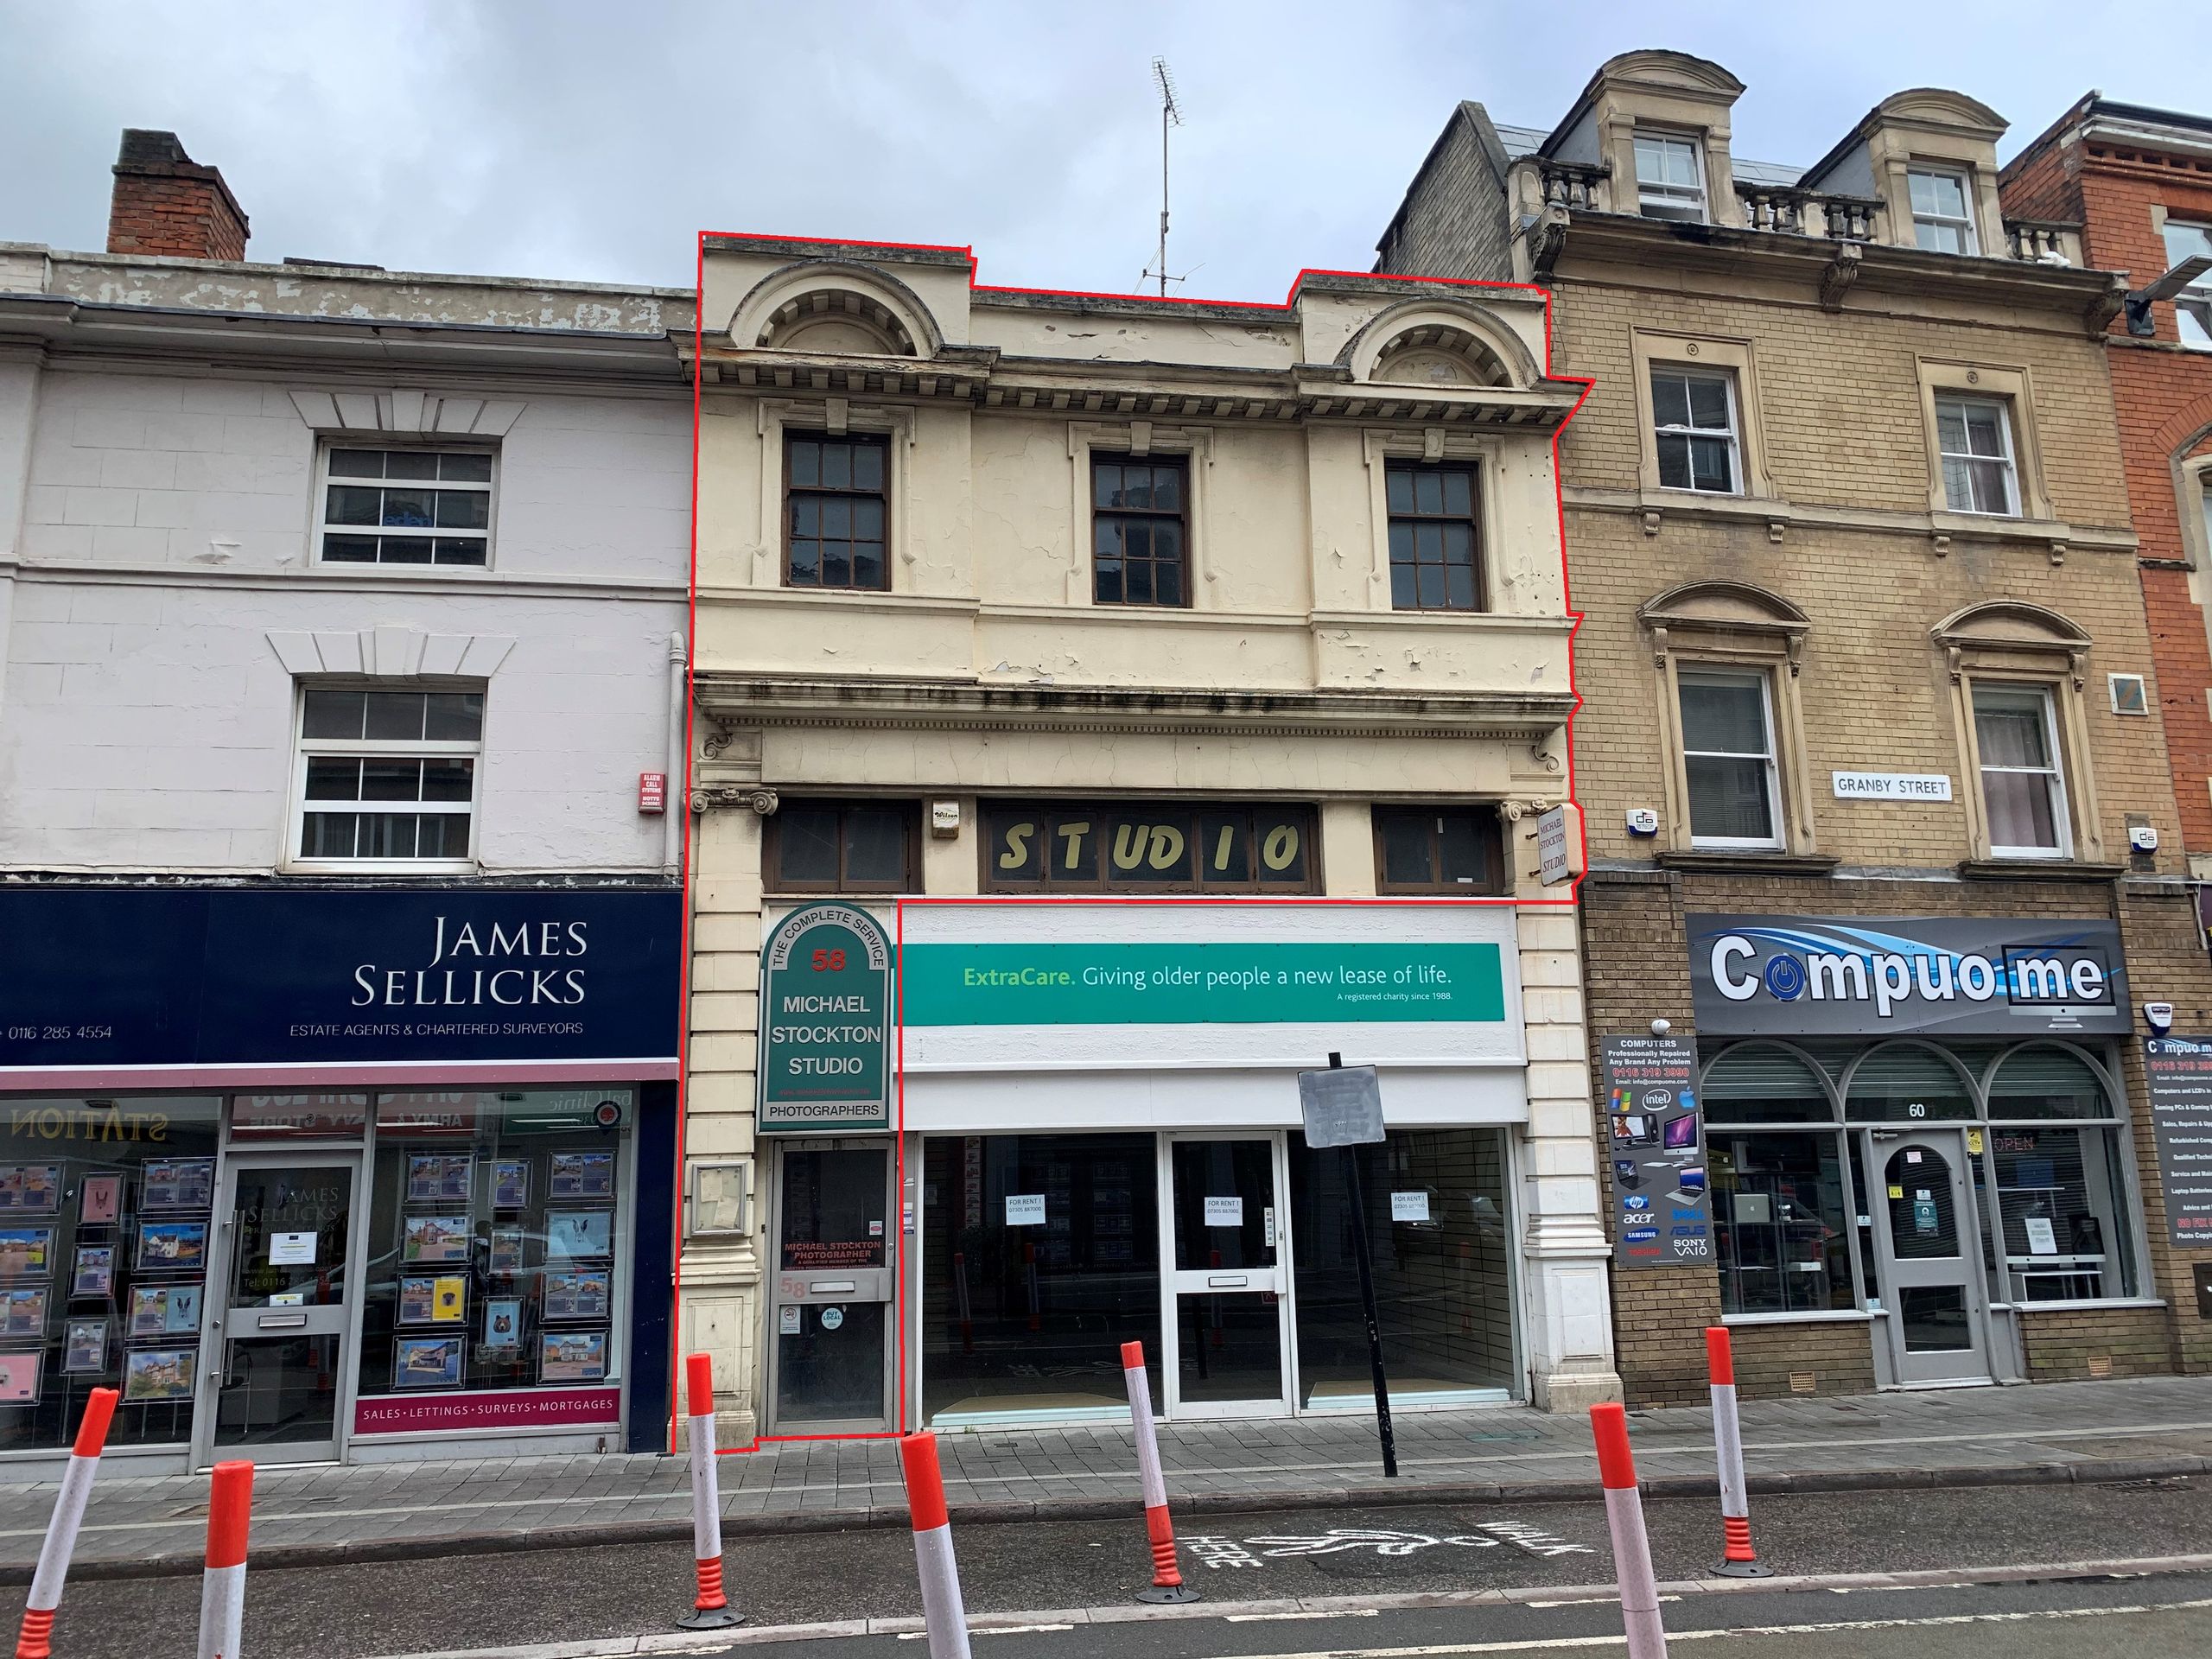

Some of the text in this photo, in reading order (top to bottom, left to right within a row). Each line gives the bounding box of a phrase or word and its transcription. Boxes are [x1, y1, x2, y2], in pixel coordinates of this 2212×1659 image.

[1838, 779, 1946, 794] GRANBY STREET
[1540, 817, 1562, 835] MICHAEL
[1000, 822, 1299, 870] STUDIO
[1540, 831, 1565, 849] STOCKTON
[1543, 854, 1566, 873] STUDIO
[428, 916, 588, 969] JAMES
[773, 910, 884, 966] THE COMPLETE SERVICE
[812, 949, 846, 971] 58
[351, 964, 586, 1006] SELLICKS
[964, 964, 1452, 991] ExtraCare. Giving older people a new lease of life.
[783, 995, 871, 1014] MICHAEL
[1344, 993, 1382, 1002] registered
[1382, 993, 1408, 1002] charity
[9, 1026, 111, 1039] 0116 285 4554
[290, 1022, 584, 1037] ESTATE AGENTS & CHARTERED SURVEYORS
[772, 1026, 881, 1044] STOCKTON
[1620, 1039, 1677, 1048] COMPUTERS
[788, 1057, 863, 1075] STUDIO
[1612, 1067, 1640, 1077] 0116
[1641, 1067, 1662, 1077] 319
[1646, 1094, 1667, 1104] intel
[770, 1104, 879, 1117] PHOTOGRAPHERS
[1909, 1103, 1925, 1117] 60
[1994, 1137, 2035, 1151] OPEN
[278, 1185, 339, 1205] JAMES
[248, 1205, 337, 1224] SELLICKS
[1624, 1213, 1655, 1224] acer
[1670, 1225, 1707, 1236] ASUS
[785, 1241, 881, 1251] MICHAEL STOCKTON
[1674, 1238, 1707, 1247] SONY
[794, 1249, 872, 1259] PHOTOGRAPHER
[1674, 1247, 1707, 1256] VAIO
[263, 1277, 286, 1287] 0116
[780, 1277, 805, 1299] 58
[363, 1399, 613, 1421] SALES LETTINGS SURVEYS MORTGAGES
[1175, 1535, 1263, 1568] HERE
